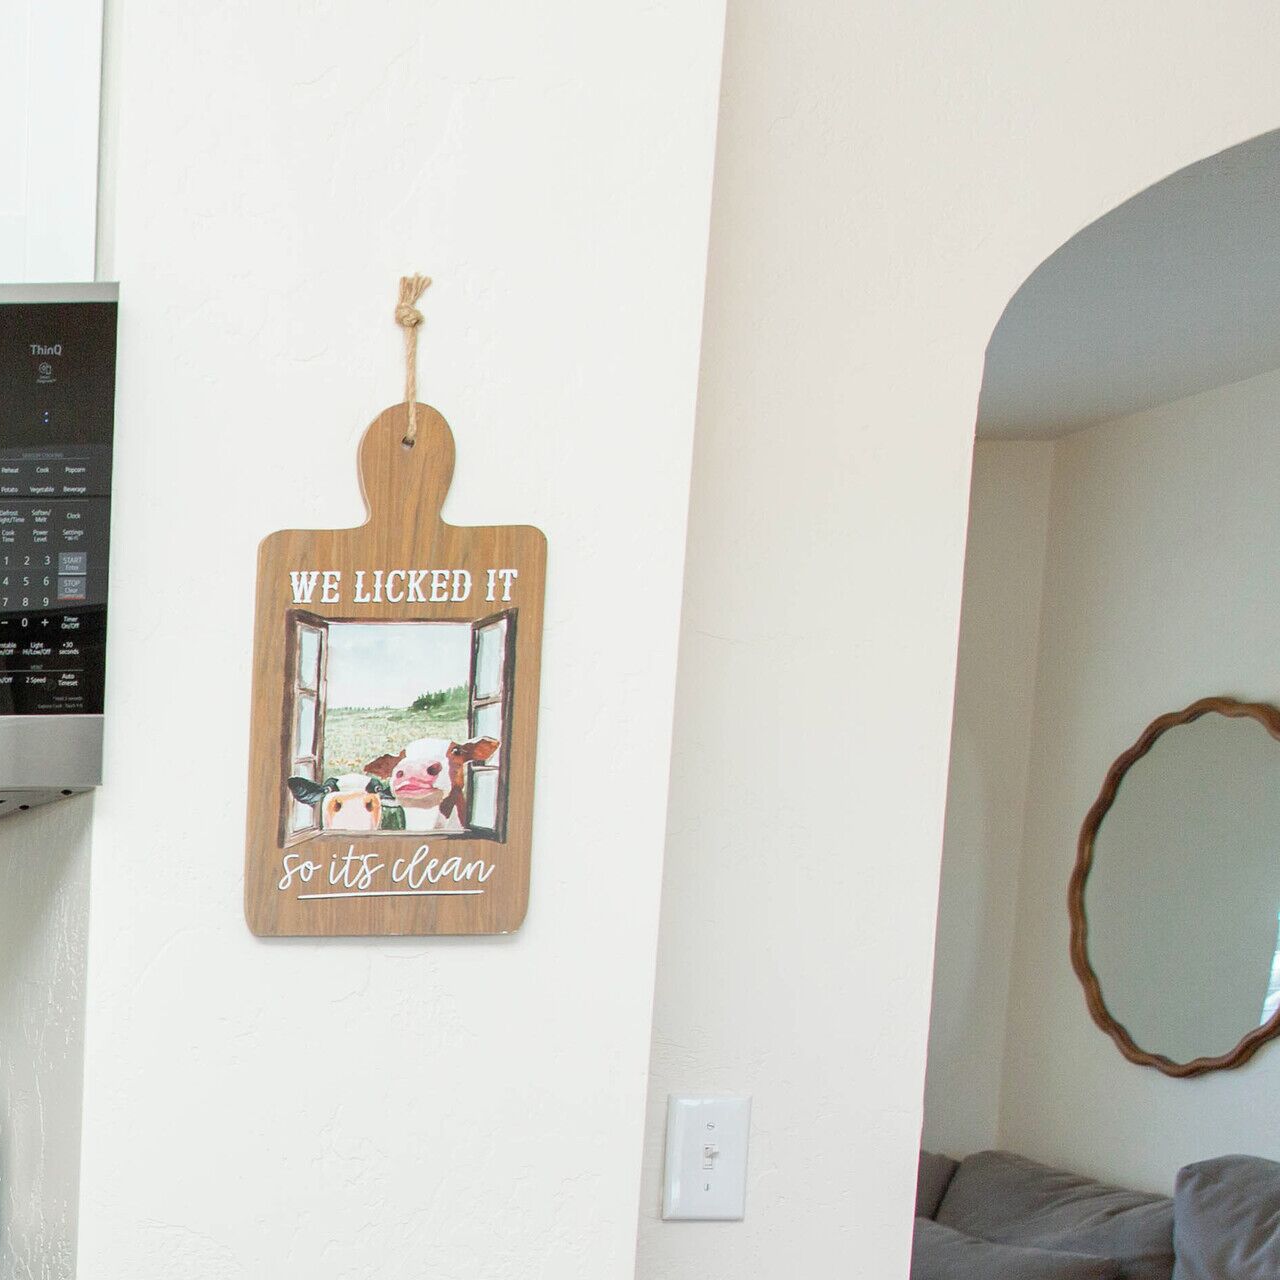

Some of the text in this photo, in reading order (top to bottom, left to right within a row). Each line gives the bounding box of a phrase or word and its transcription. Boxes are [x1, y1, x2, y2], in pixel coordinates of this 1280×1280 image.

[29, 344, 62, 356] ThinQ
[36, 466, 49, 474] Cook
[65, 466, 86, 475] Popcorn
[0, 486, 19, 494] Potato
[30, 486, 55, 495] Vegetable
[63, 486, 87, 494] Beverage
[66, 512, 81, 520] Clock
[62, 529, 84, 537] Settings
[4, 556, 9, 566] 1
[23, 556, 30, 566] 2
[44, 556, 51, 565] 3
[62, 556, 82, 564] START
[2, 576, 9, 586] 4
[22, 576, 30, 586] 5
[43, 576, 50, 586] 6
[63, 579, 81, 587] STOP
[289, 568, 519, 604] WE LICKED IT
[2, 597, 9, 607] 7
[22, 597, 29, 607] 8
[42, 597, 50, 607] 9
[21, 618, 28, 627] 0
[30, 641, 44, 649] Light
[30, 676, 47, 685] Speed
[61, 672, 75, 680] Auto
[391, 843, 497, 889] clean
